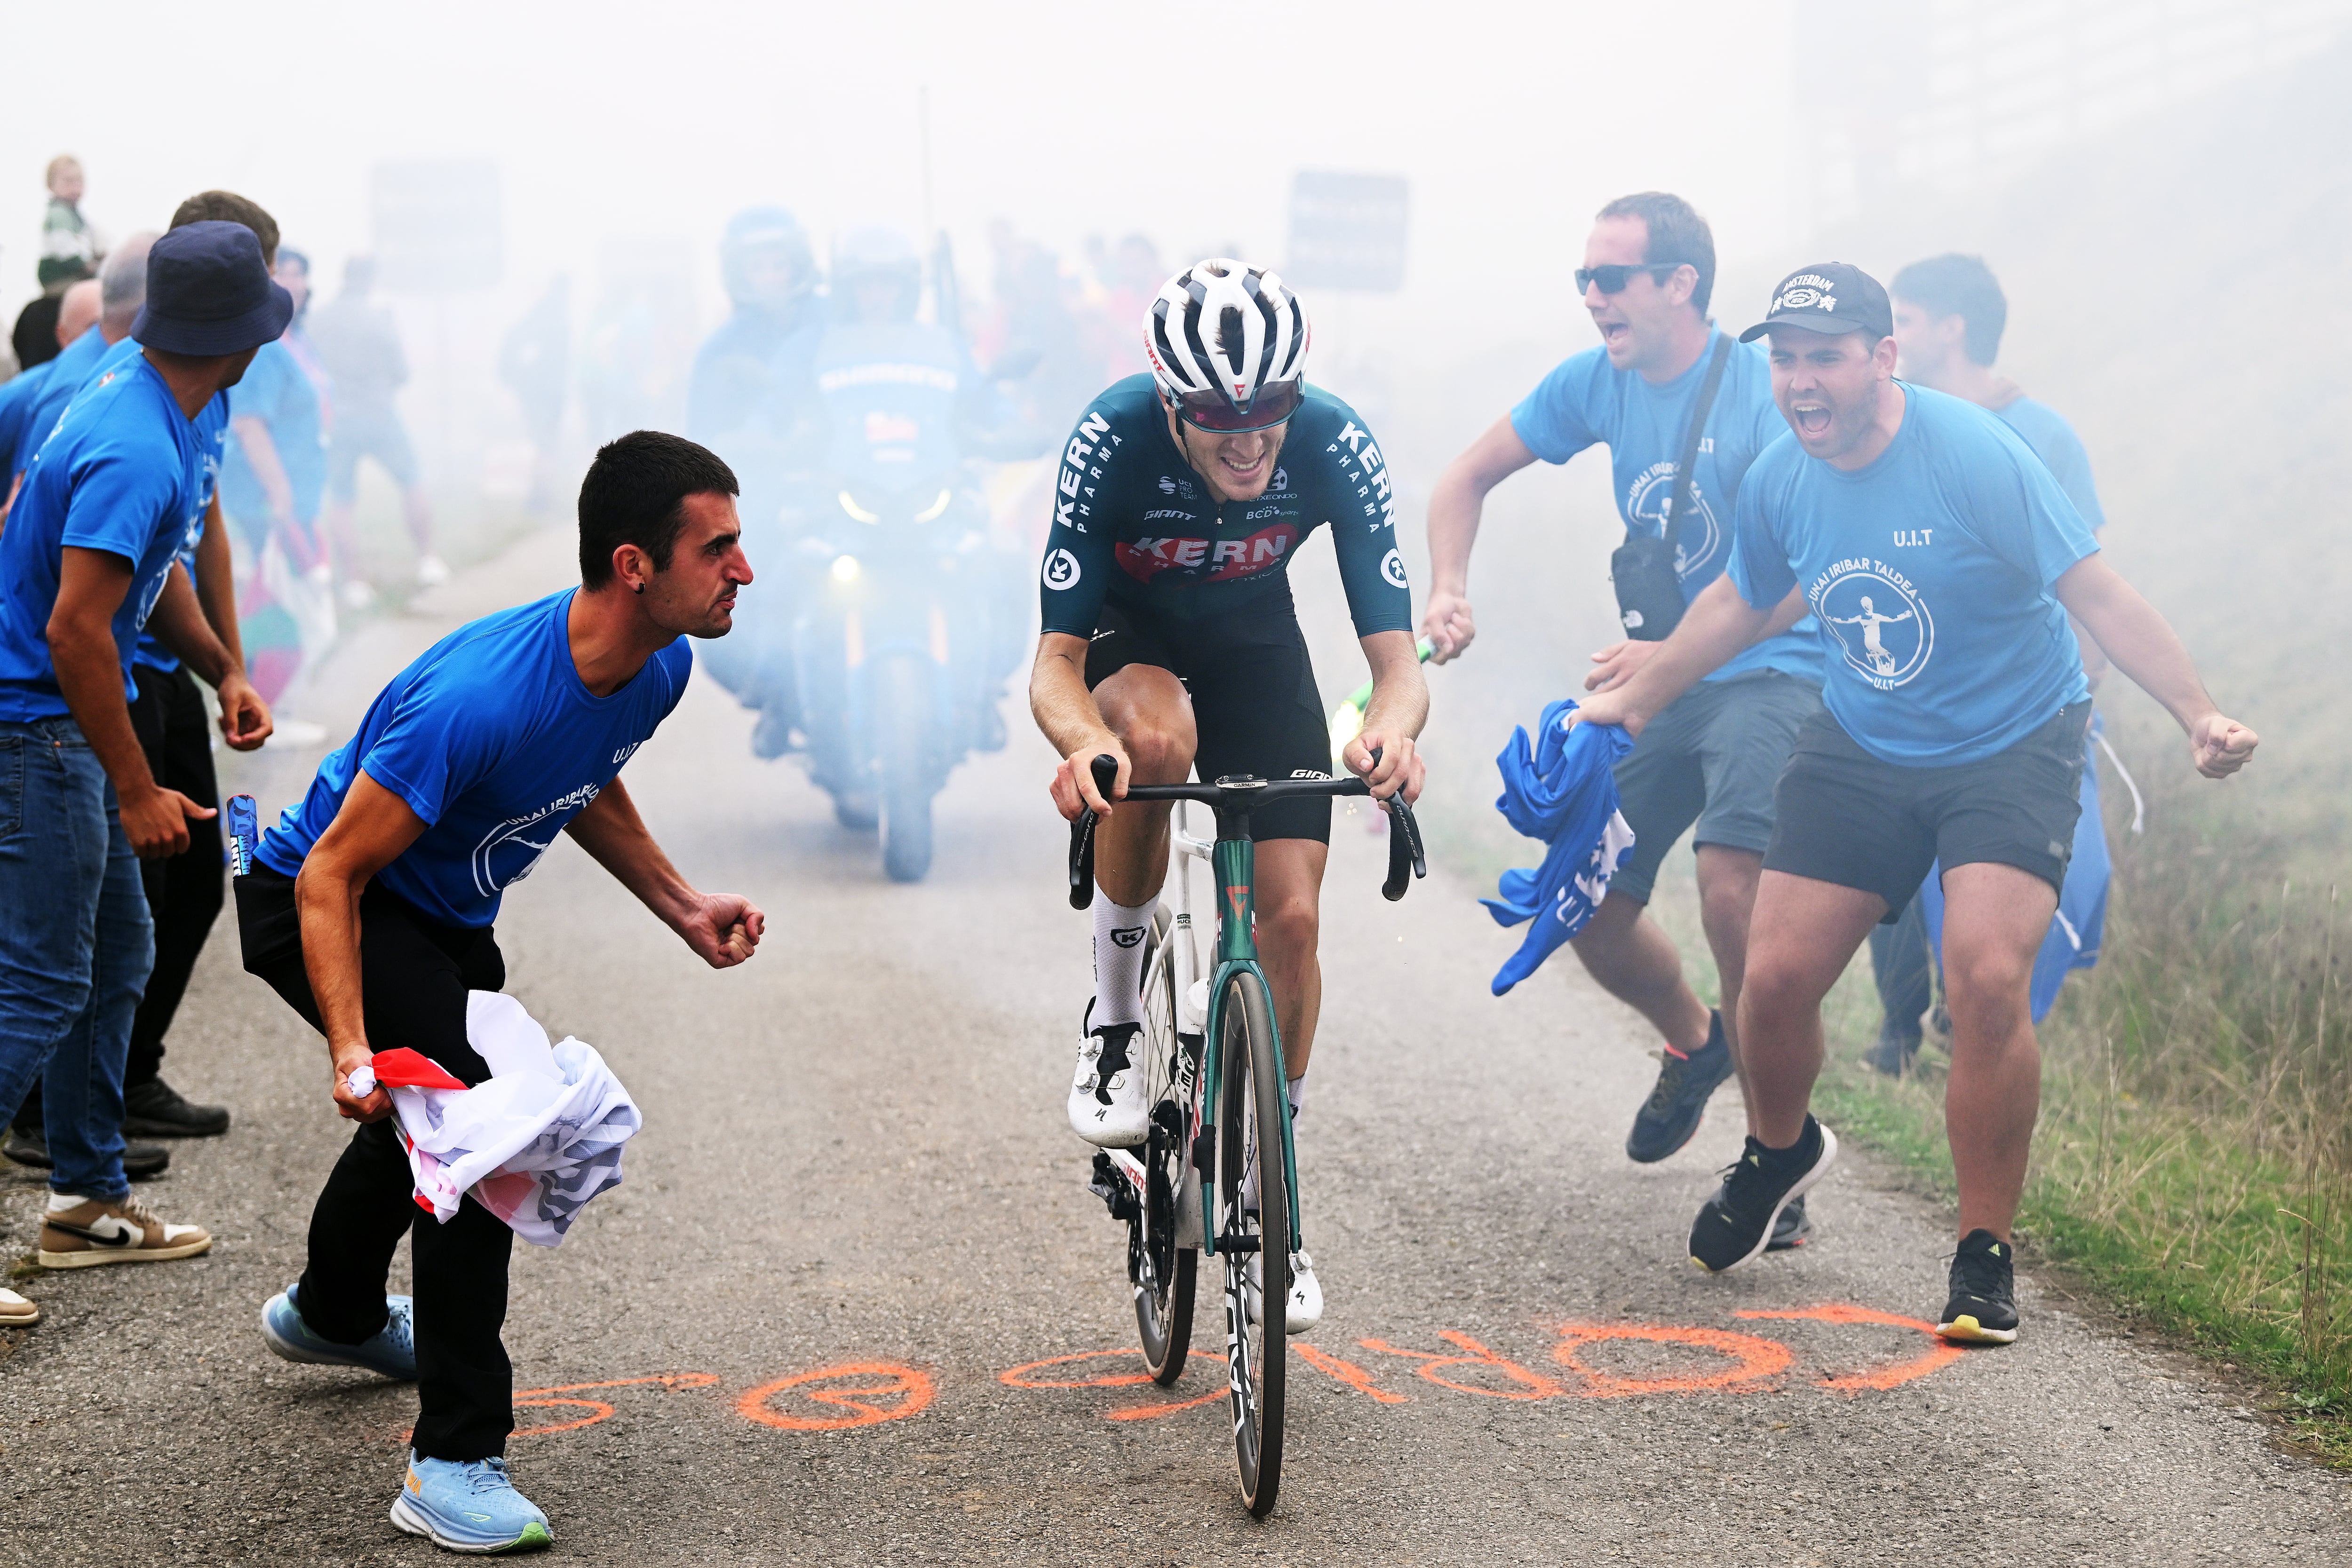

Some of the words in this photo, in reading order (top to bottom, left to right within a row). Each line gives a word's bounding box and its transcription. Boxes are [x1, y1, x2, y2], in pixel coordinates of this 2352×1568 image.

[1782, 274, 1834, 293] AMSTERDAM
[1144, 329, 1166, 372] GIANT
[1057, 411, 1111, 528] KERN
[1077, 435, 1122, 533] PHARMA
[1178, 478, 1192, 488] UCI
[1326, 443, 1379, 533] PHARMA
[1337, 420, 1394, 528] KERN
[1144, 509, 1197, 521] GIANT
[1246, 508, 1272, 520] BCD
[1133, 534, 1287, 567] KERN
[1893, 529, 1932, 547] U.I.T
[1128, 548, 1281, 575] PHARMA
[1809, 572, 1830, 602] UNAI
[1828, 557, 1870, 578] IRIBAR
[1874, 560, 1918, 599] TALDEA
[1873, 677, 1896, 690] U.I.T
[506, 807, 546, 825] UNAI
[551, 784, 589, 811] IRIBAR
[1397, 805, 1418, 858] DURA-ACE
